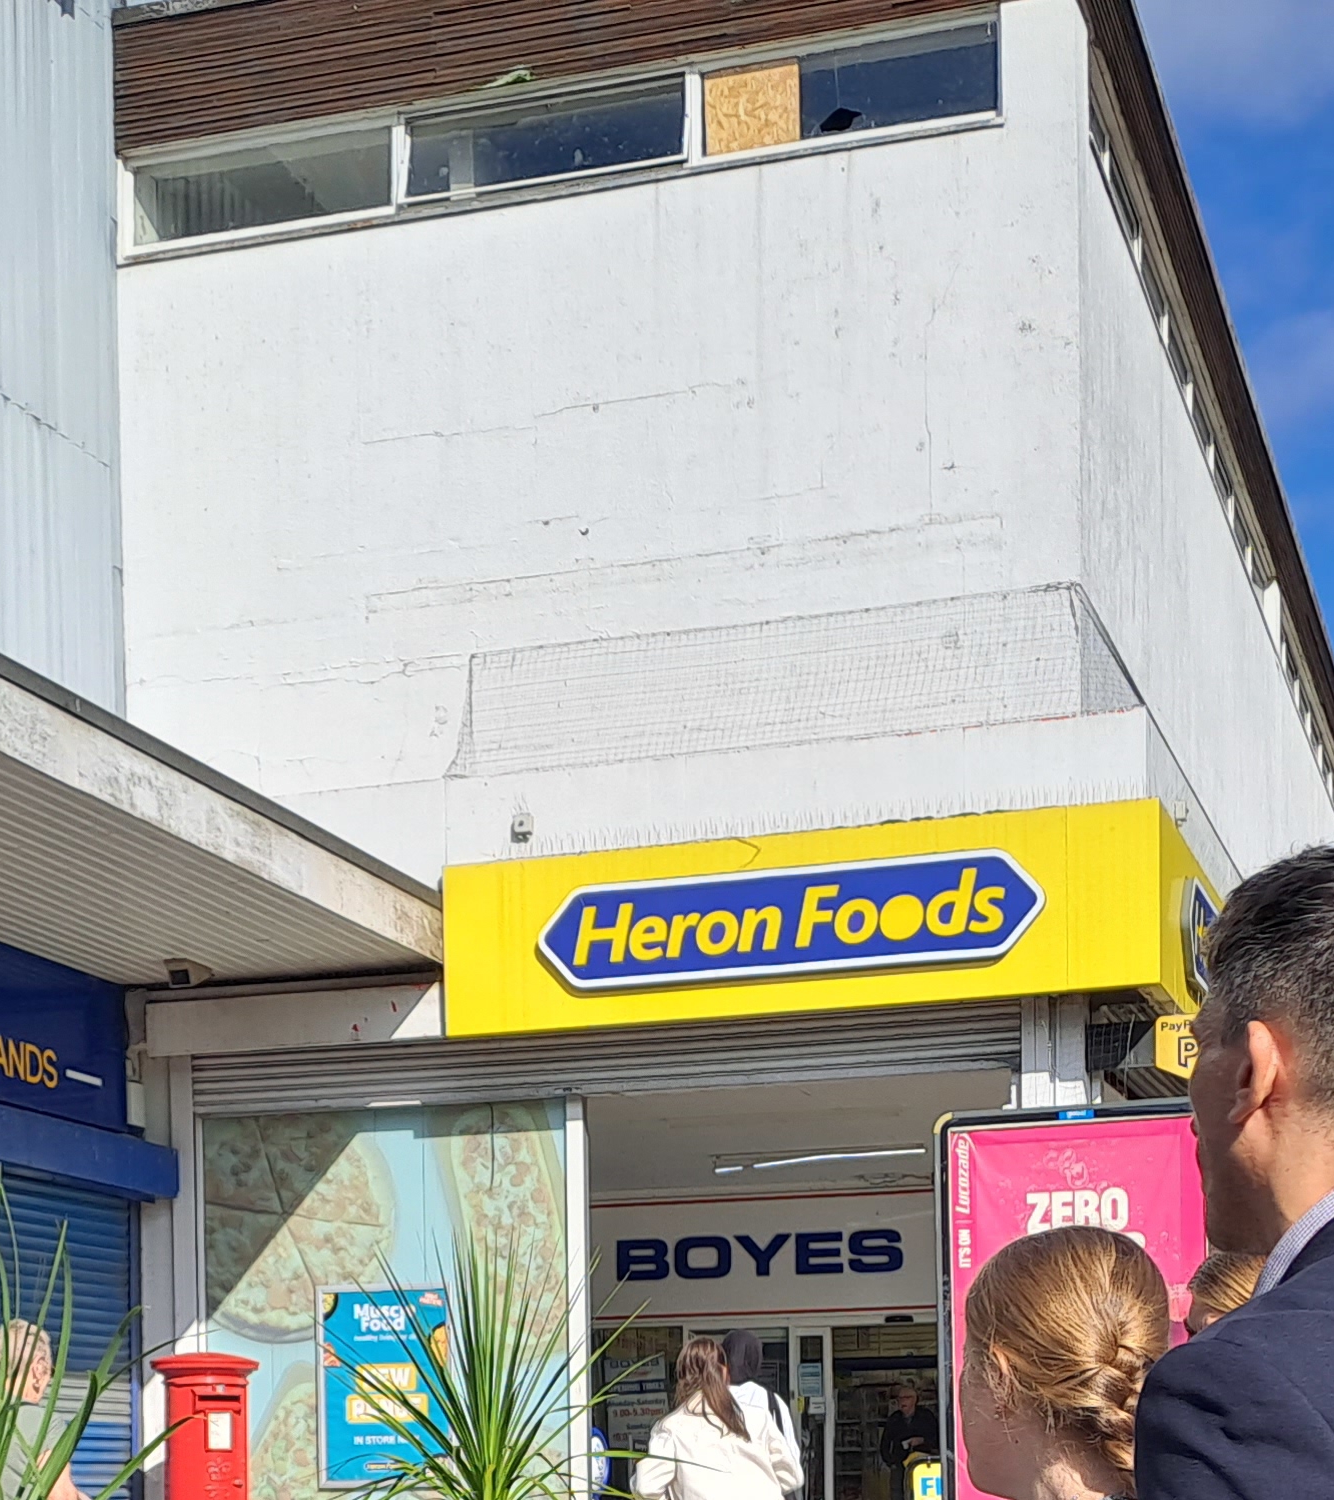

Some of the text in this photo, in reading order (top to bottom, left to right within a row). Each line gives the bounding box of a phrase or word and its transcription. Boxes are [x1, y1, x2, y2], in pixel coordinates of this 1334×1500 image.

[572, 867, 1006, 966] Heron Foods
[955, 1139, 971, 1215] Lucozade
[1025, 1187, 1130, 1235] ZERO
[616, 1228, 904, 1281] BOYES
[360, 1318, 406, 1332] Food
